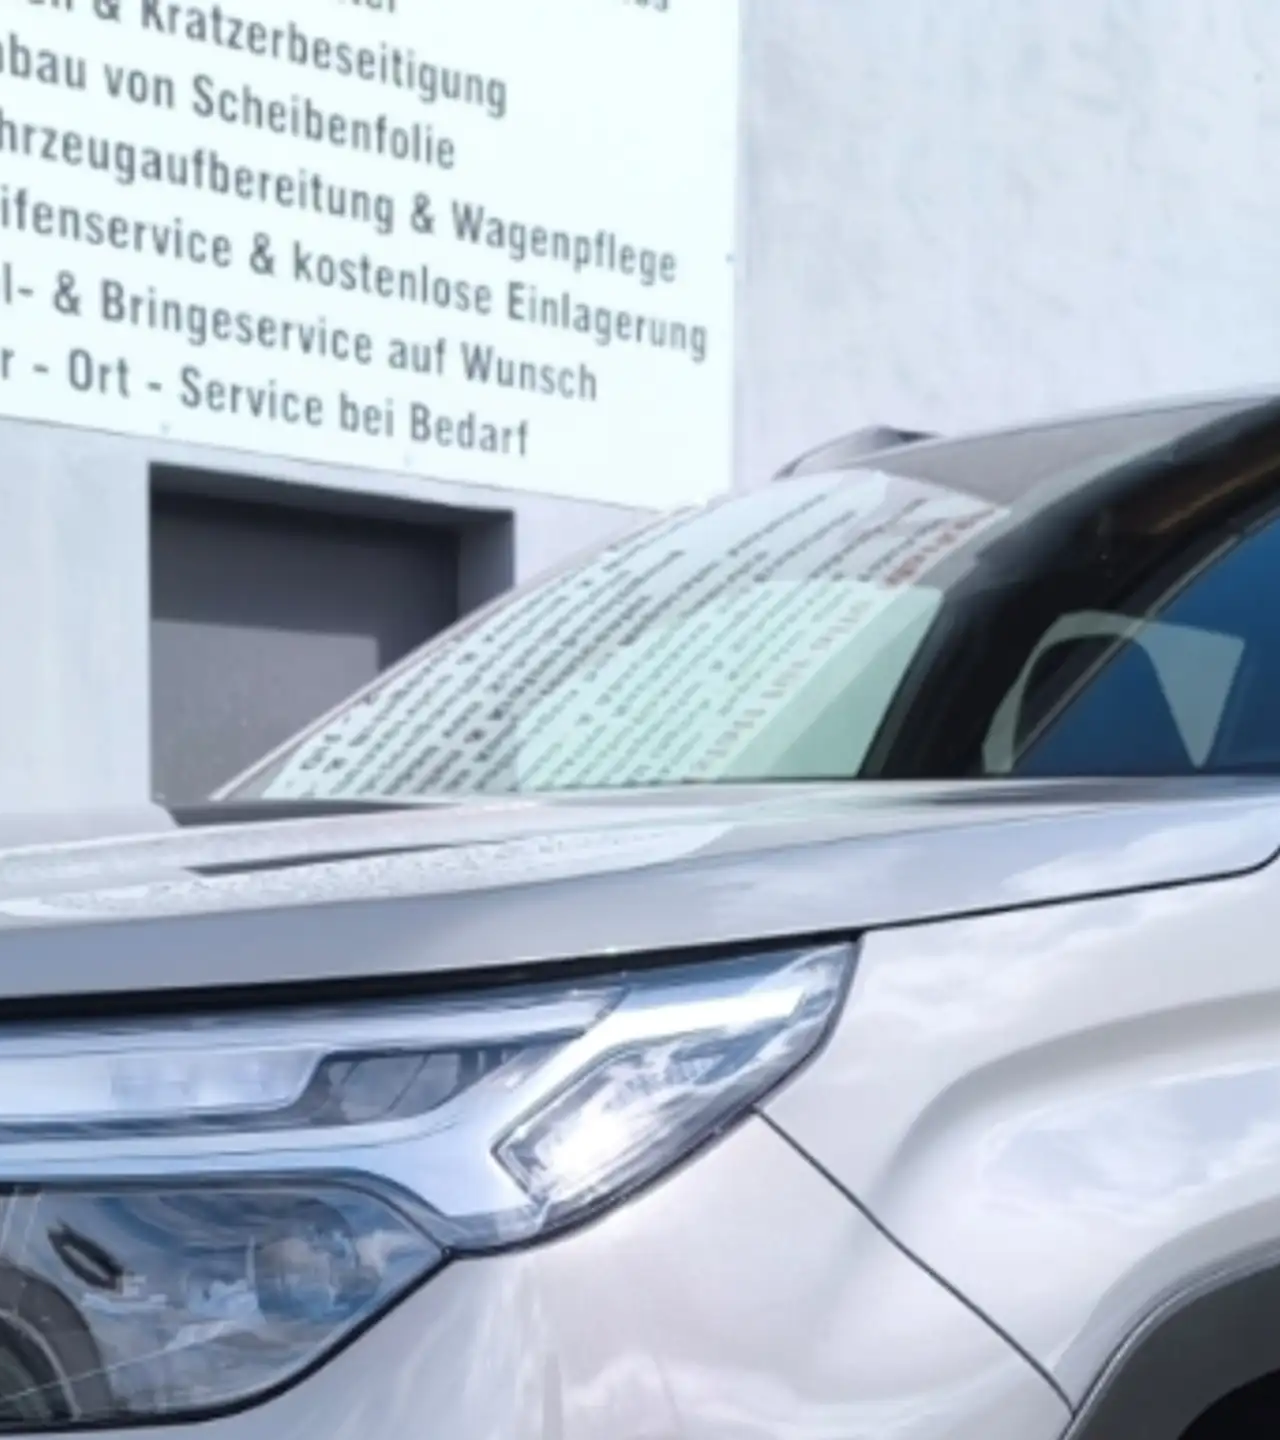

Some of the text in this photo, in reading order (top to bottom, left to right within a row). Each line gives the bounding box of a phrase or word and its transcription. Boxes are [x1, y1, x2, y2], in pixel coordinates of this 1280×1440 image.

[104, 63, 175, 109] von
[192, 73, 455, 170] Scheibenfolie
[140, 0, 507, 119] Kratzerbeseitigung
[410, 191, 435, 235] &
[451, 199, 677, 287] Wagenpflege
[53, 269, 81, 316] &
[101, 278, 373, 365] Bringeservice
[387, 336, 446, 376] auf
[460, 340, 597, 401] Wunsch
[249, 232, 275, 276] &
[292, 239, 493, 316] kostenlose
[507, 280, 708, 363] Einlagerung
[32, 363, 50, 375] -
[69, 348, 130, 399] Ort
[147, 380, 163, 392] -
[180, 364, 323, 427] Service
[338, 389, 395, 438] bei
[409, 401, 529, 457] Bedarf
